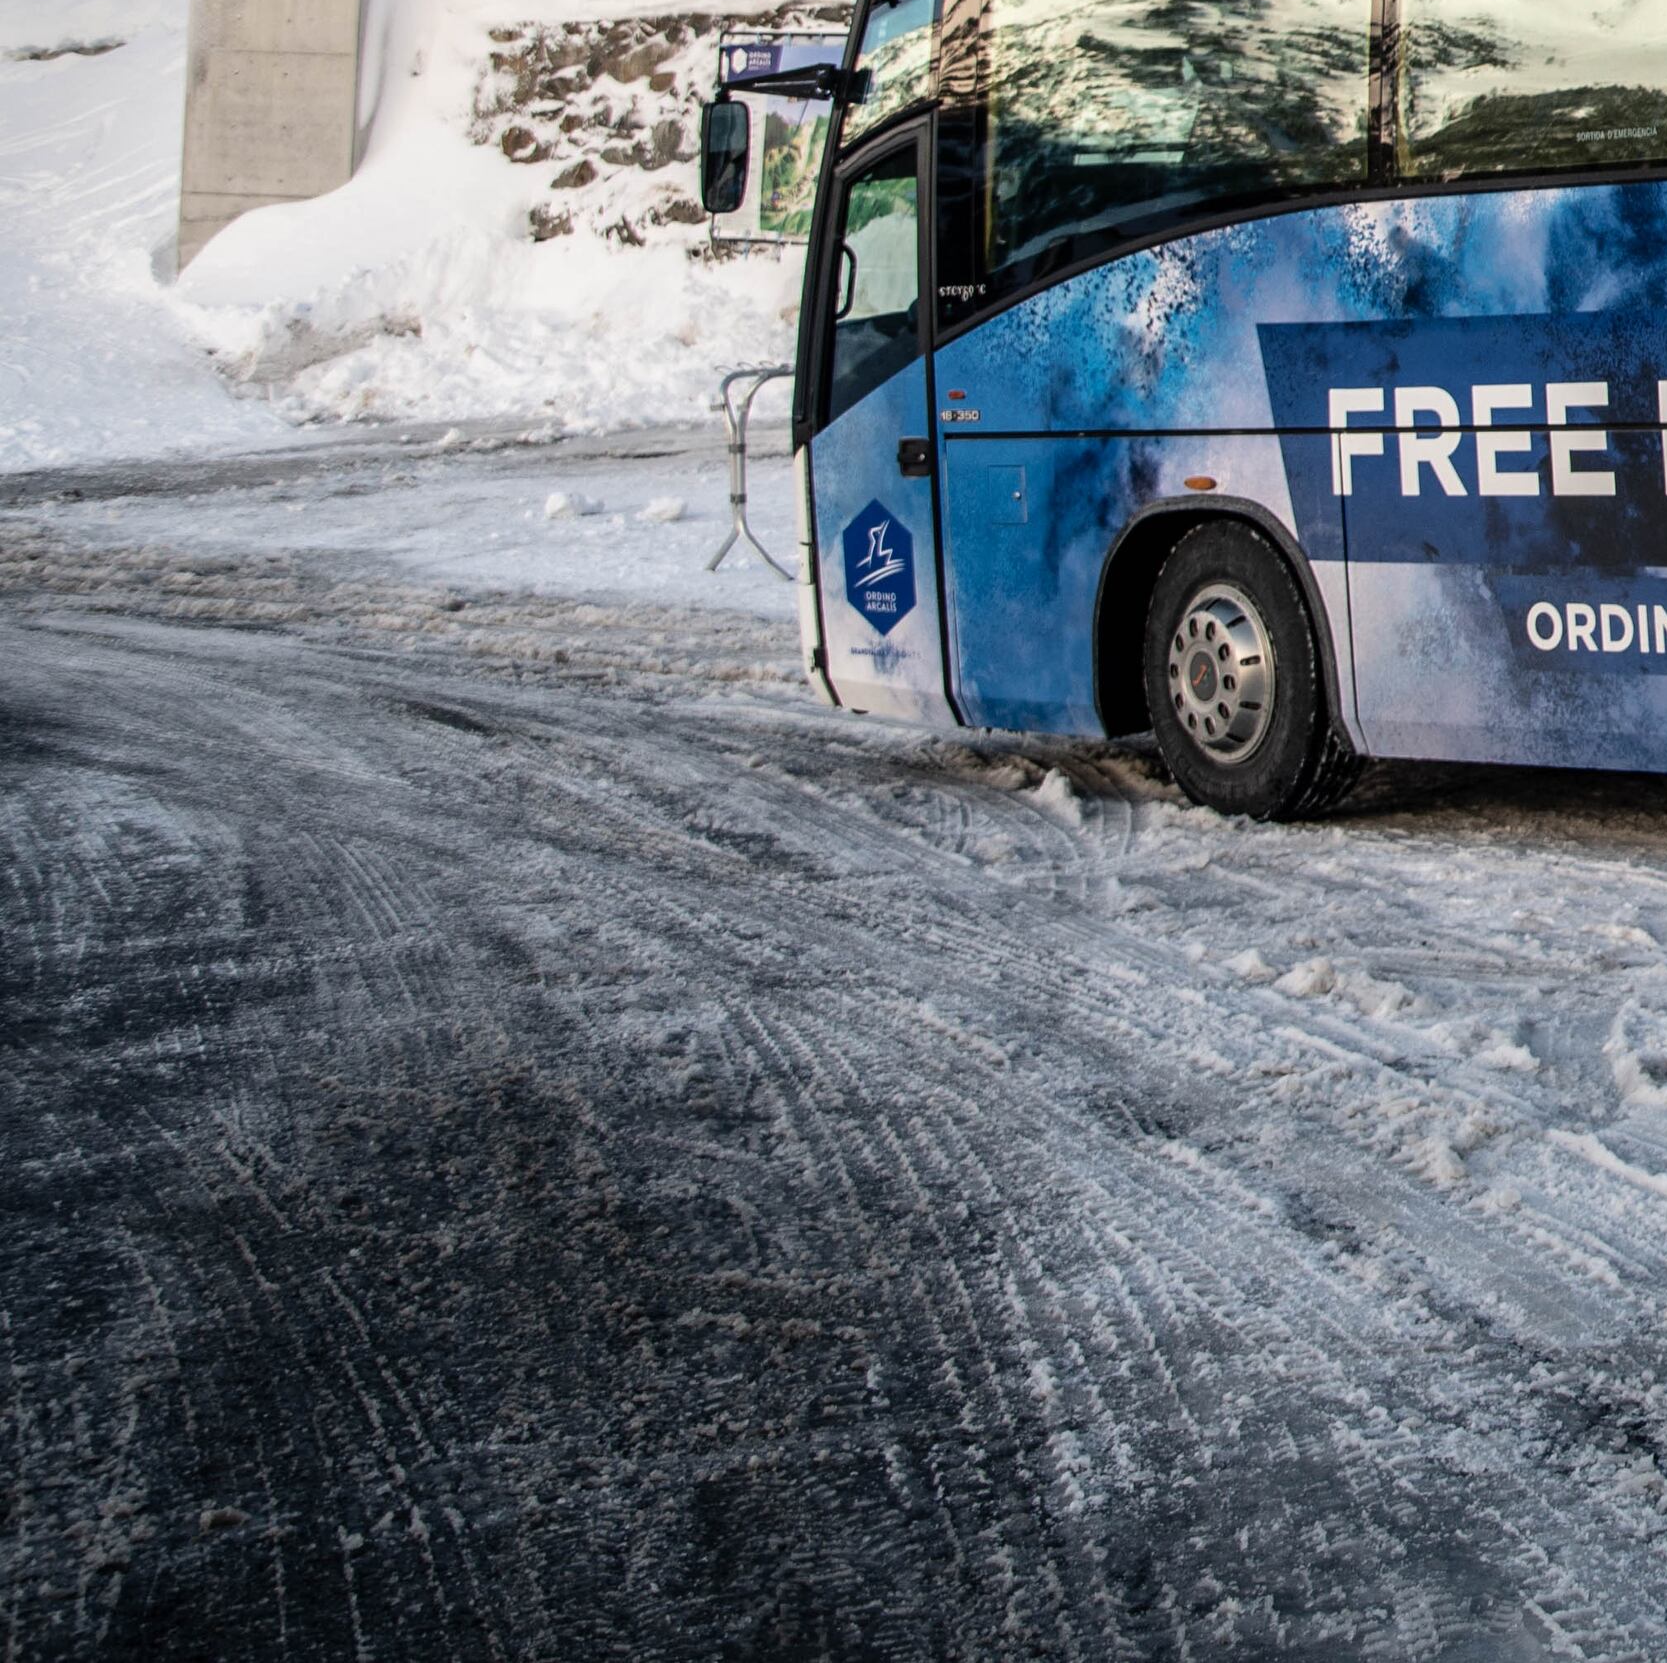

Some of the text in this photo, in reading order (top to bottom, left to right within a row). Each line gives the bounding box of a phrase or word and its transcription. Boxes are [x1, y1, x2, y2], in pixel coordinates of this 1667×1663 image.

[1576, 130, 1606, 143] SORTIDA
[1327, 381, 1616, 498] FREE
[865, 591, 897, 601] ORDINO
